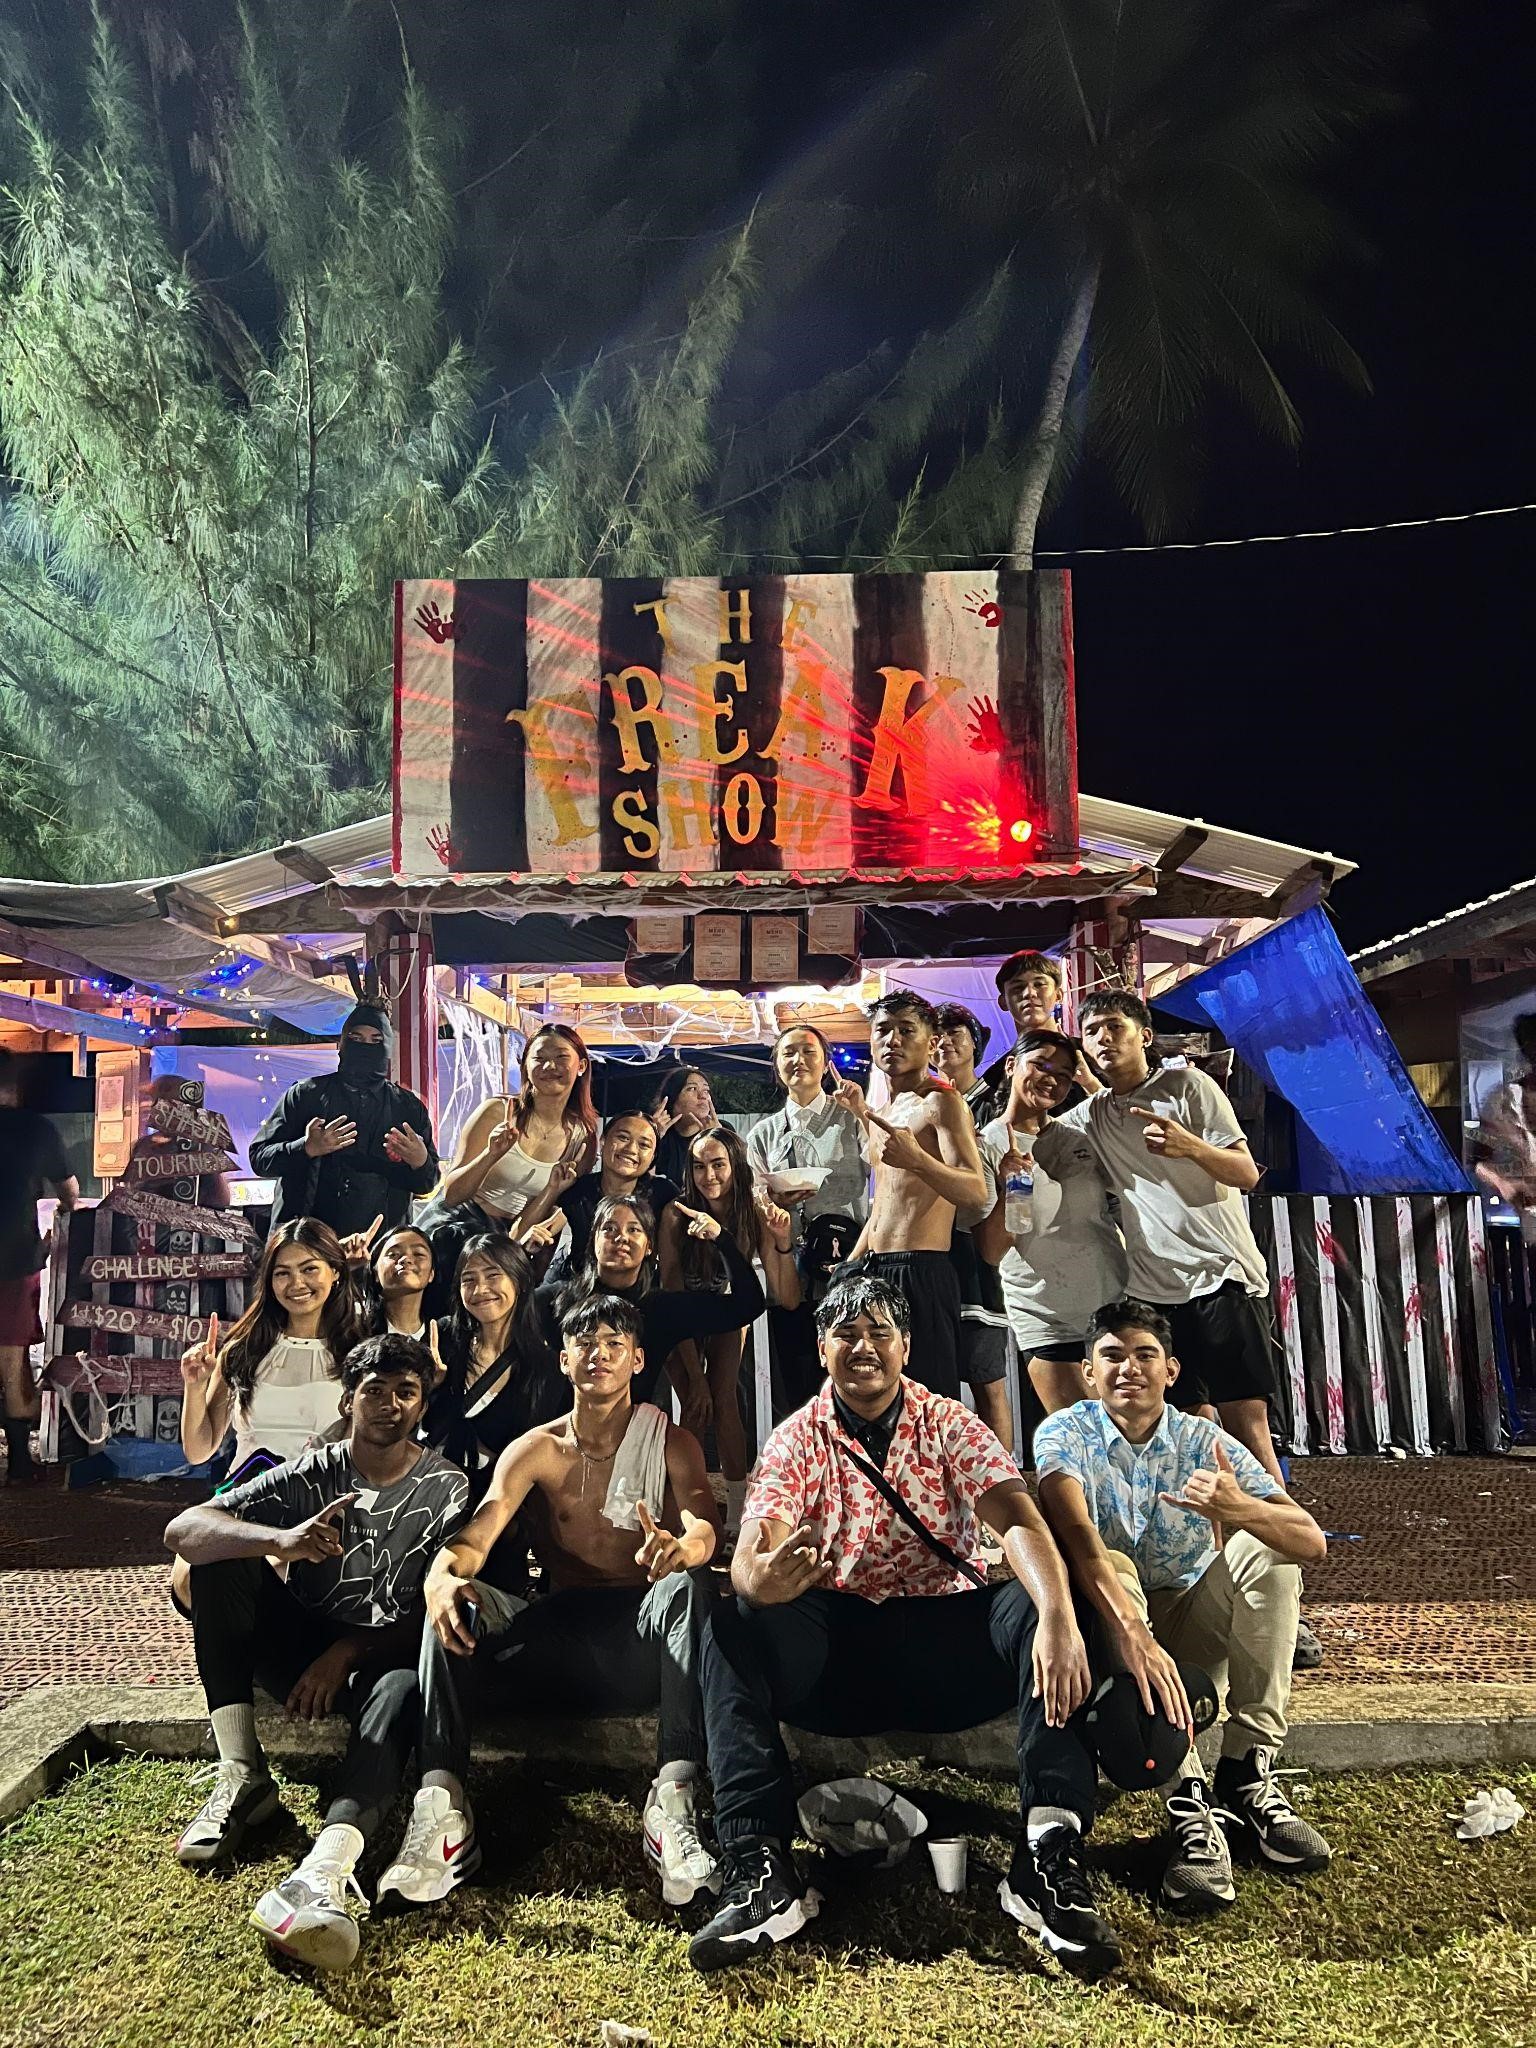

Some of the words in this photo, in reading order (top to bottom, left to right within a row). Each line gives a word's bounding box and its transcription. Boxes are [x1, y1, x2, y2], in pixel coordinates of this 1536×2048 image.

[633, 588, 818, 655] THE
[504, 660, 967, 847] FREAK
[611, 772, 831, 860] SHOW
[91, 1256, 198, 1281] CHALLENGE
[94, 1305, 136, 1333] $20
[146, 1314, 164, 1325] 2nd
